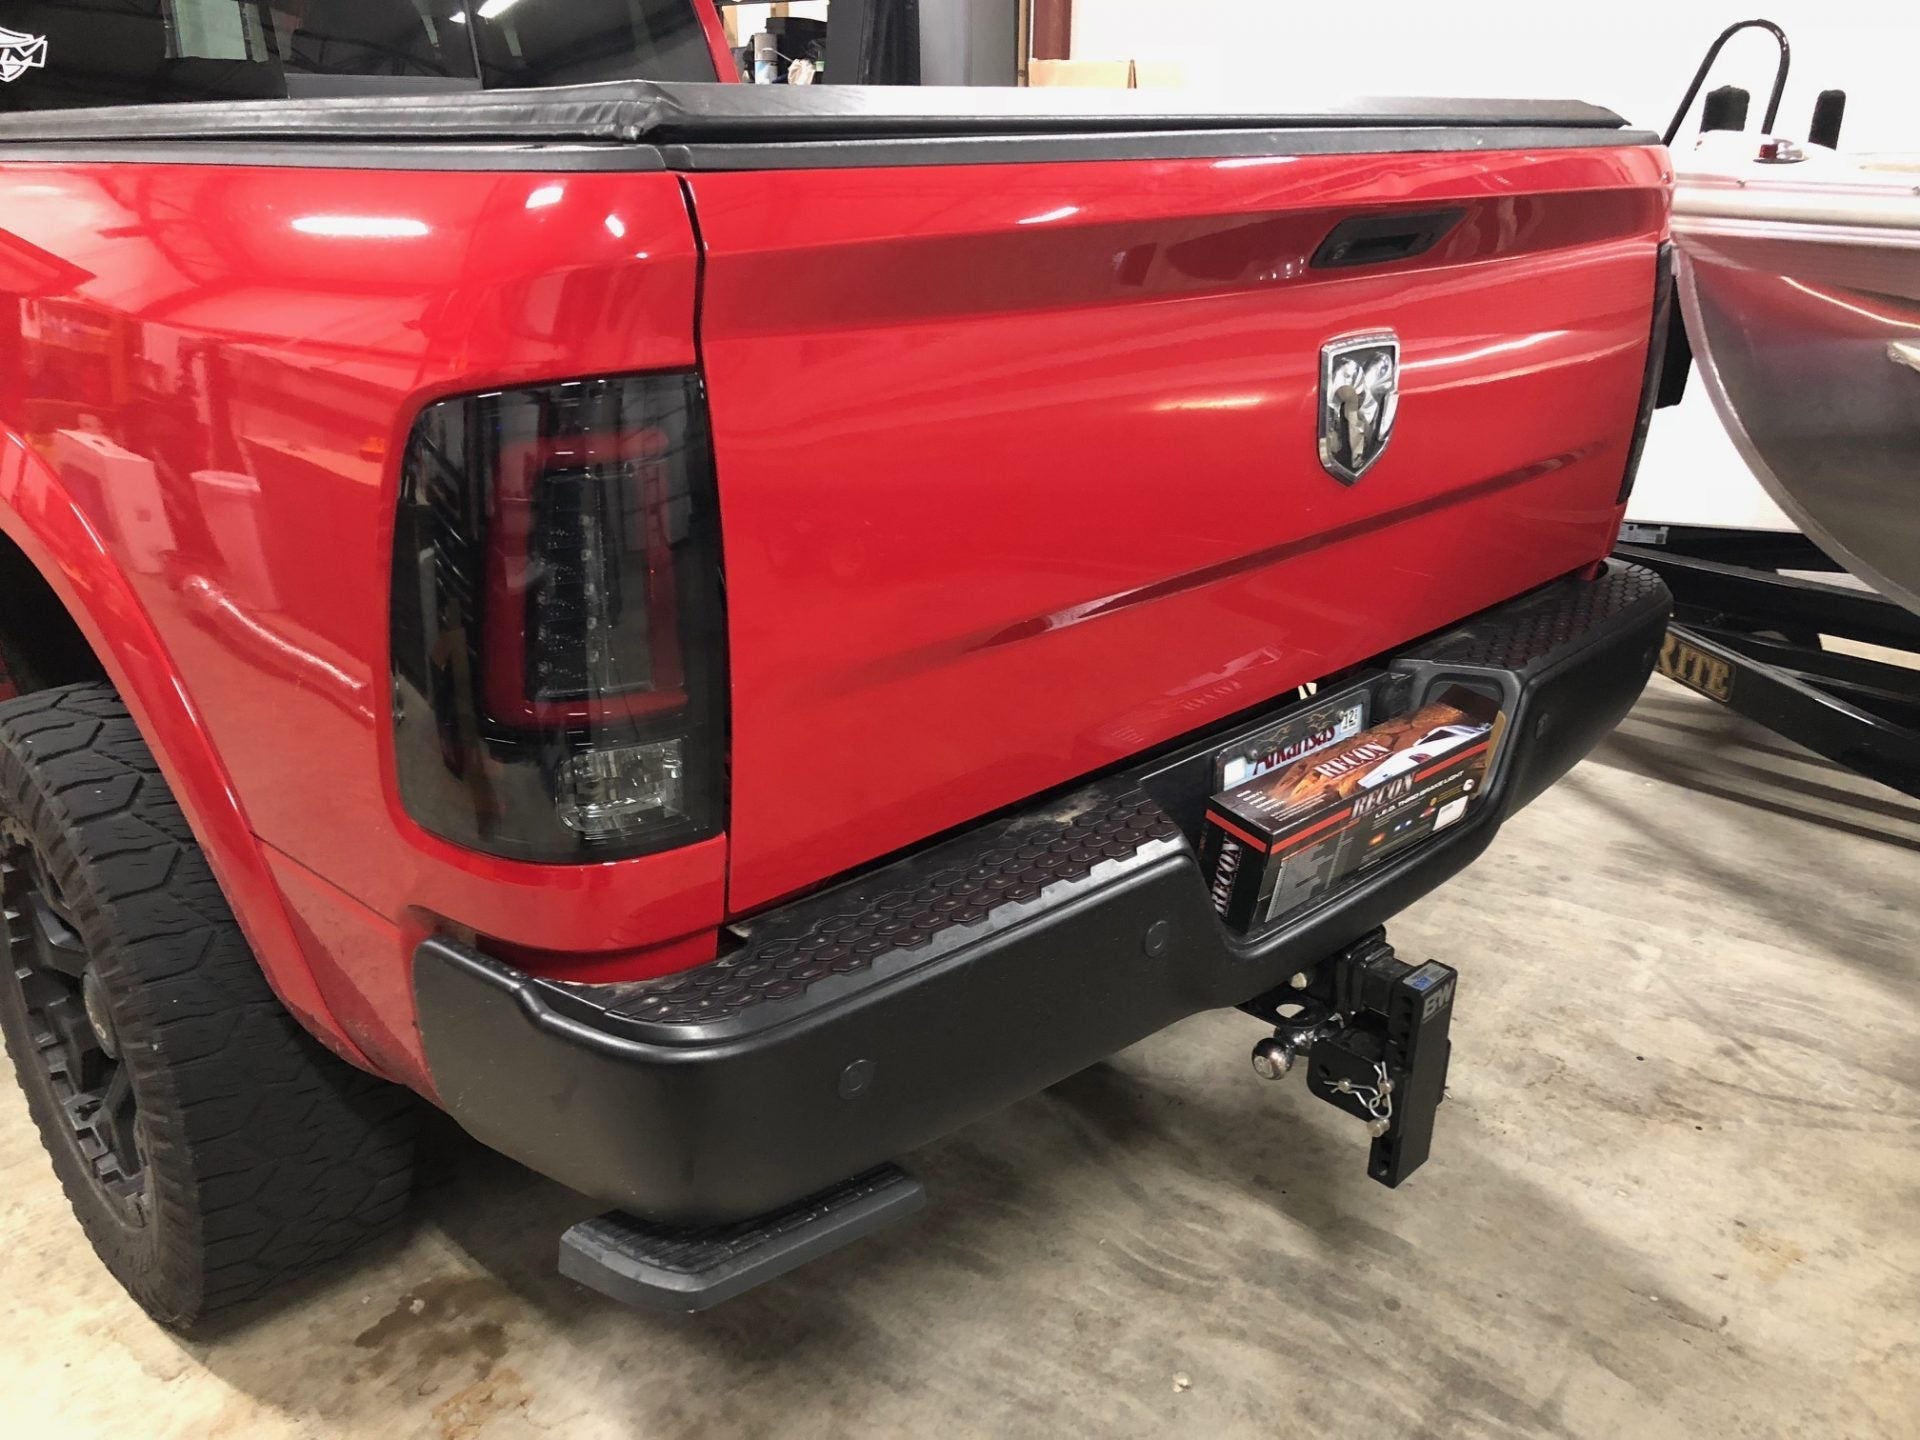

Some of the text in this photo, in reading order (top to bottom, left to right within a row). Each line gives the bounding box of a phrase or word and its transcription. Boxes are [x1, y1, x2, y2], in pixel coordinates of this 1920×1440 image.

[1314, 741, 1389, 778] RECON
[1351, 772, 1418, 818] RECON
[1211, 834, 1241, 914] RECON
